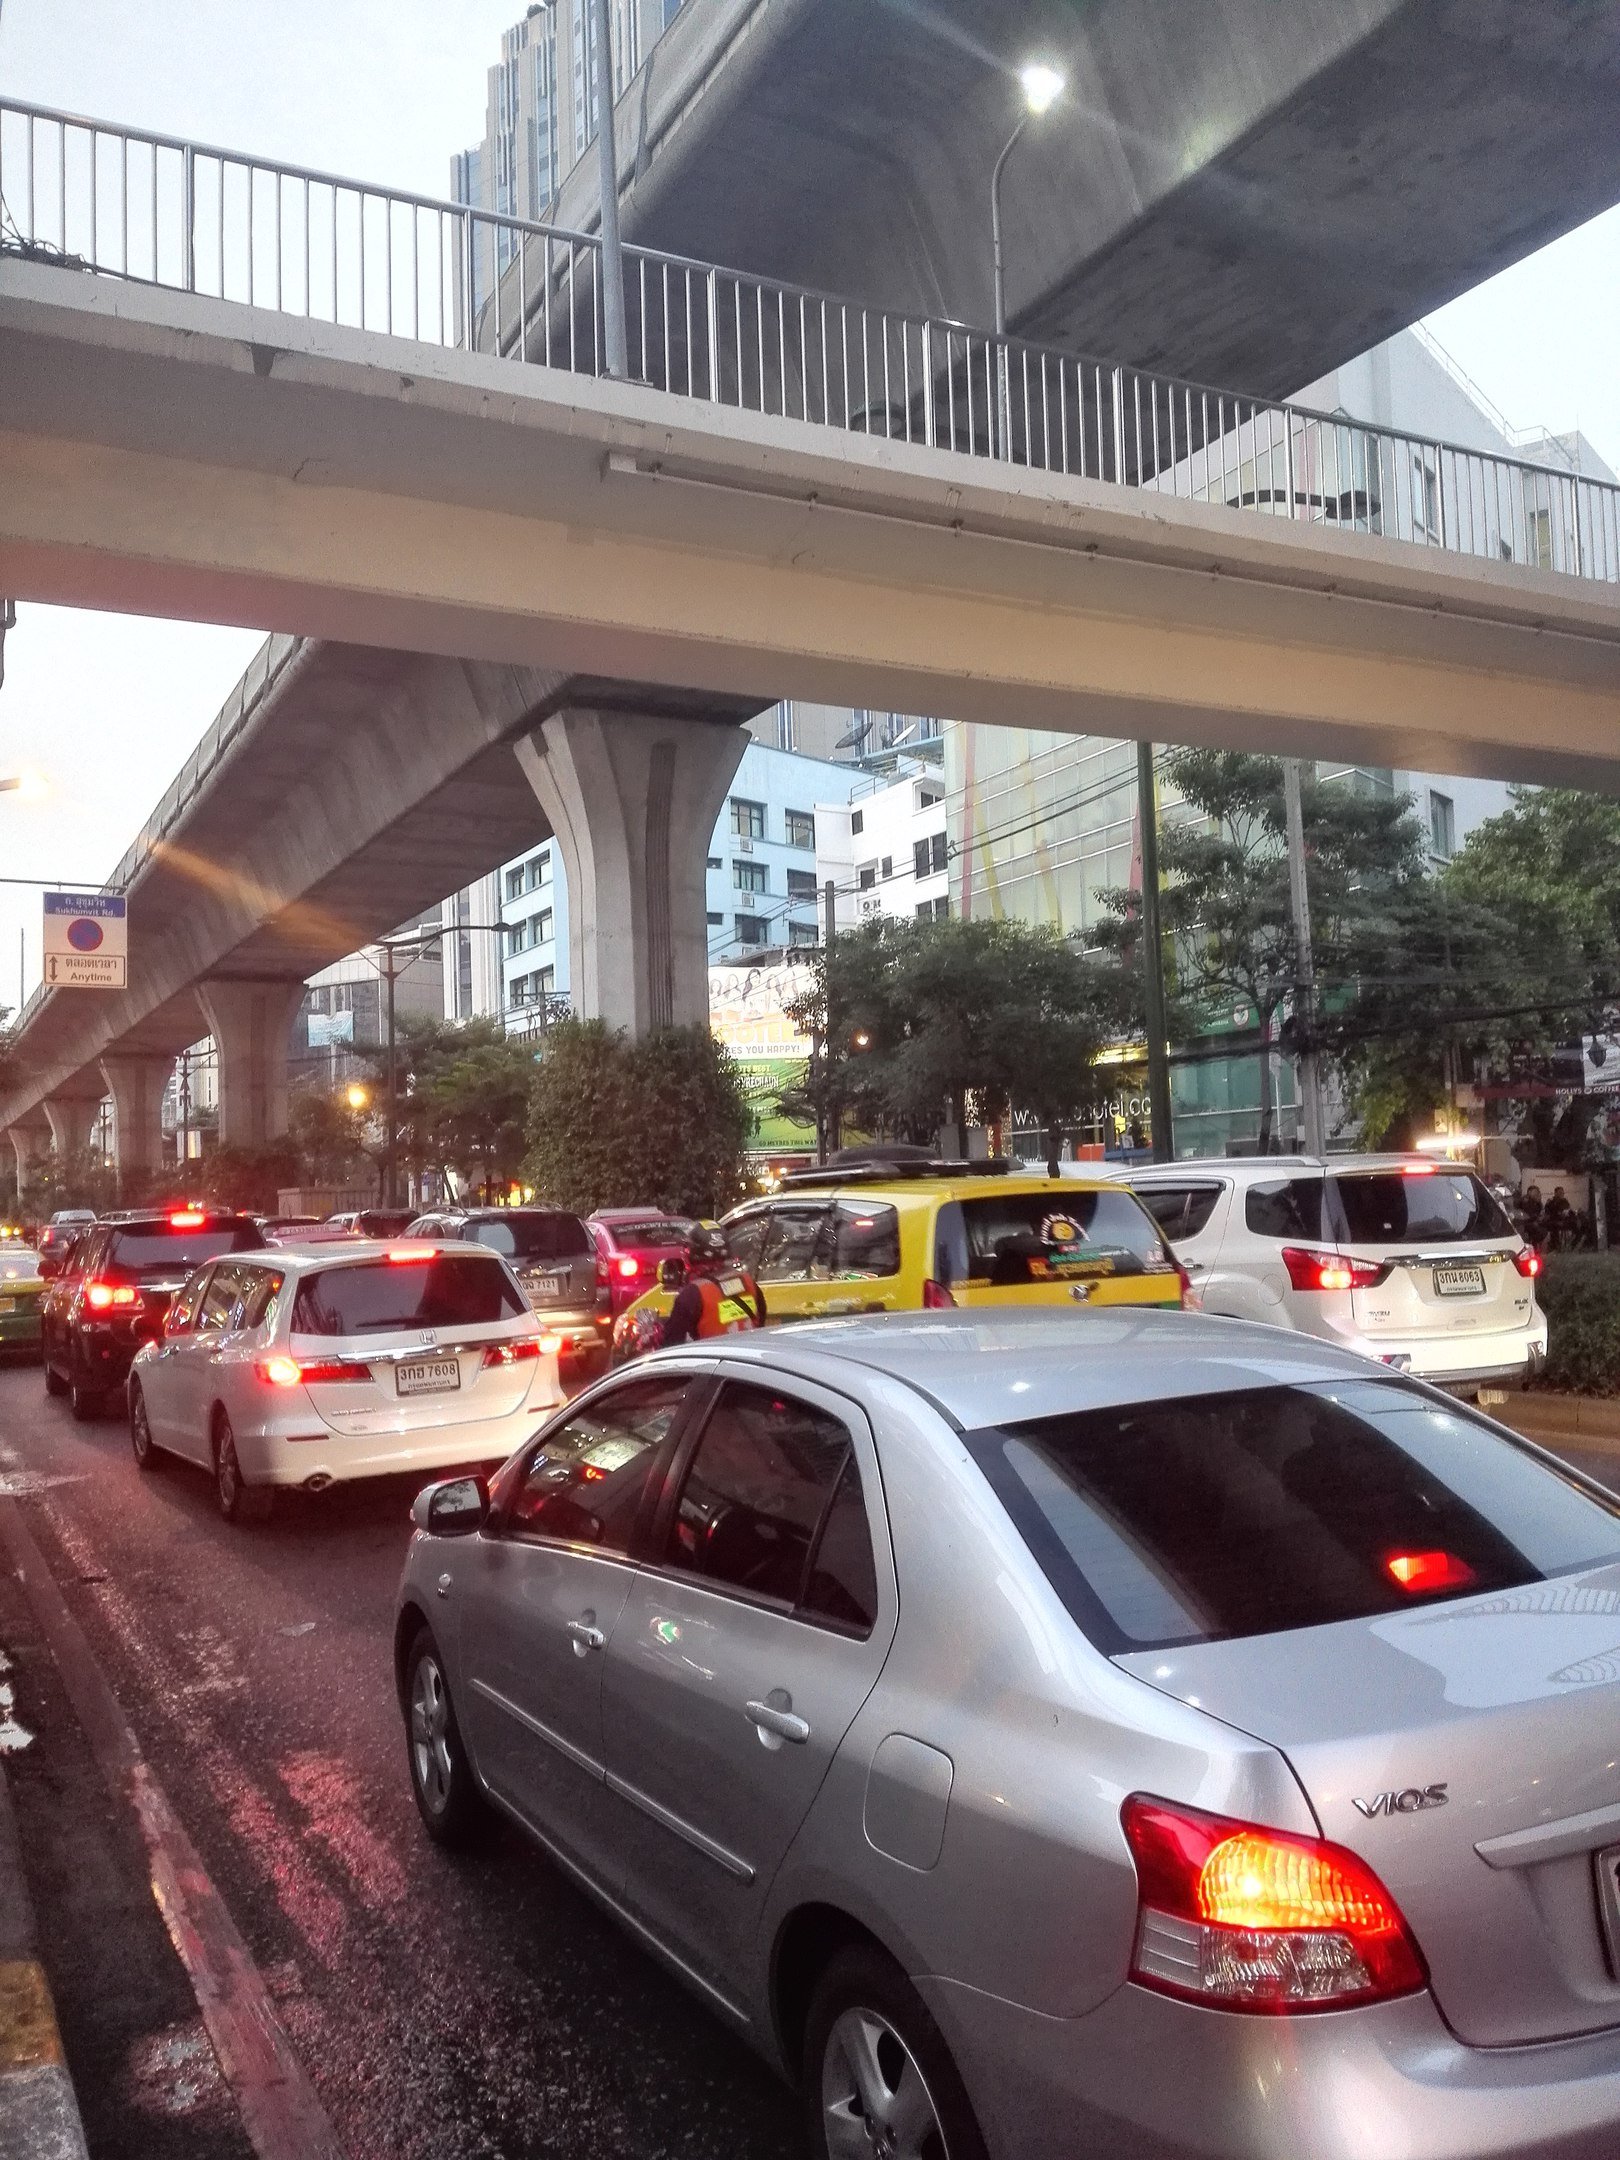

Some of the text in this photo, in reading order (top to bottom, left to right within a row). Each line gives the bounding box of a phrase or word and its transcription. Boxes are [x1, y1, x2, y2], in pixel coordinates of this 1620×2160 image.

[70, 972, 112, 983] Anytime
[746, 1045, 764, 1054] YOU
[767, 1044, 800, 1054] HAPPY!
[1555, 1087, 1581, 1095] HOLLYS
[427, 1363, 456, 1378] 7608
[1351, 1782, 1449, 1818] VIOS
